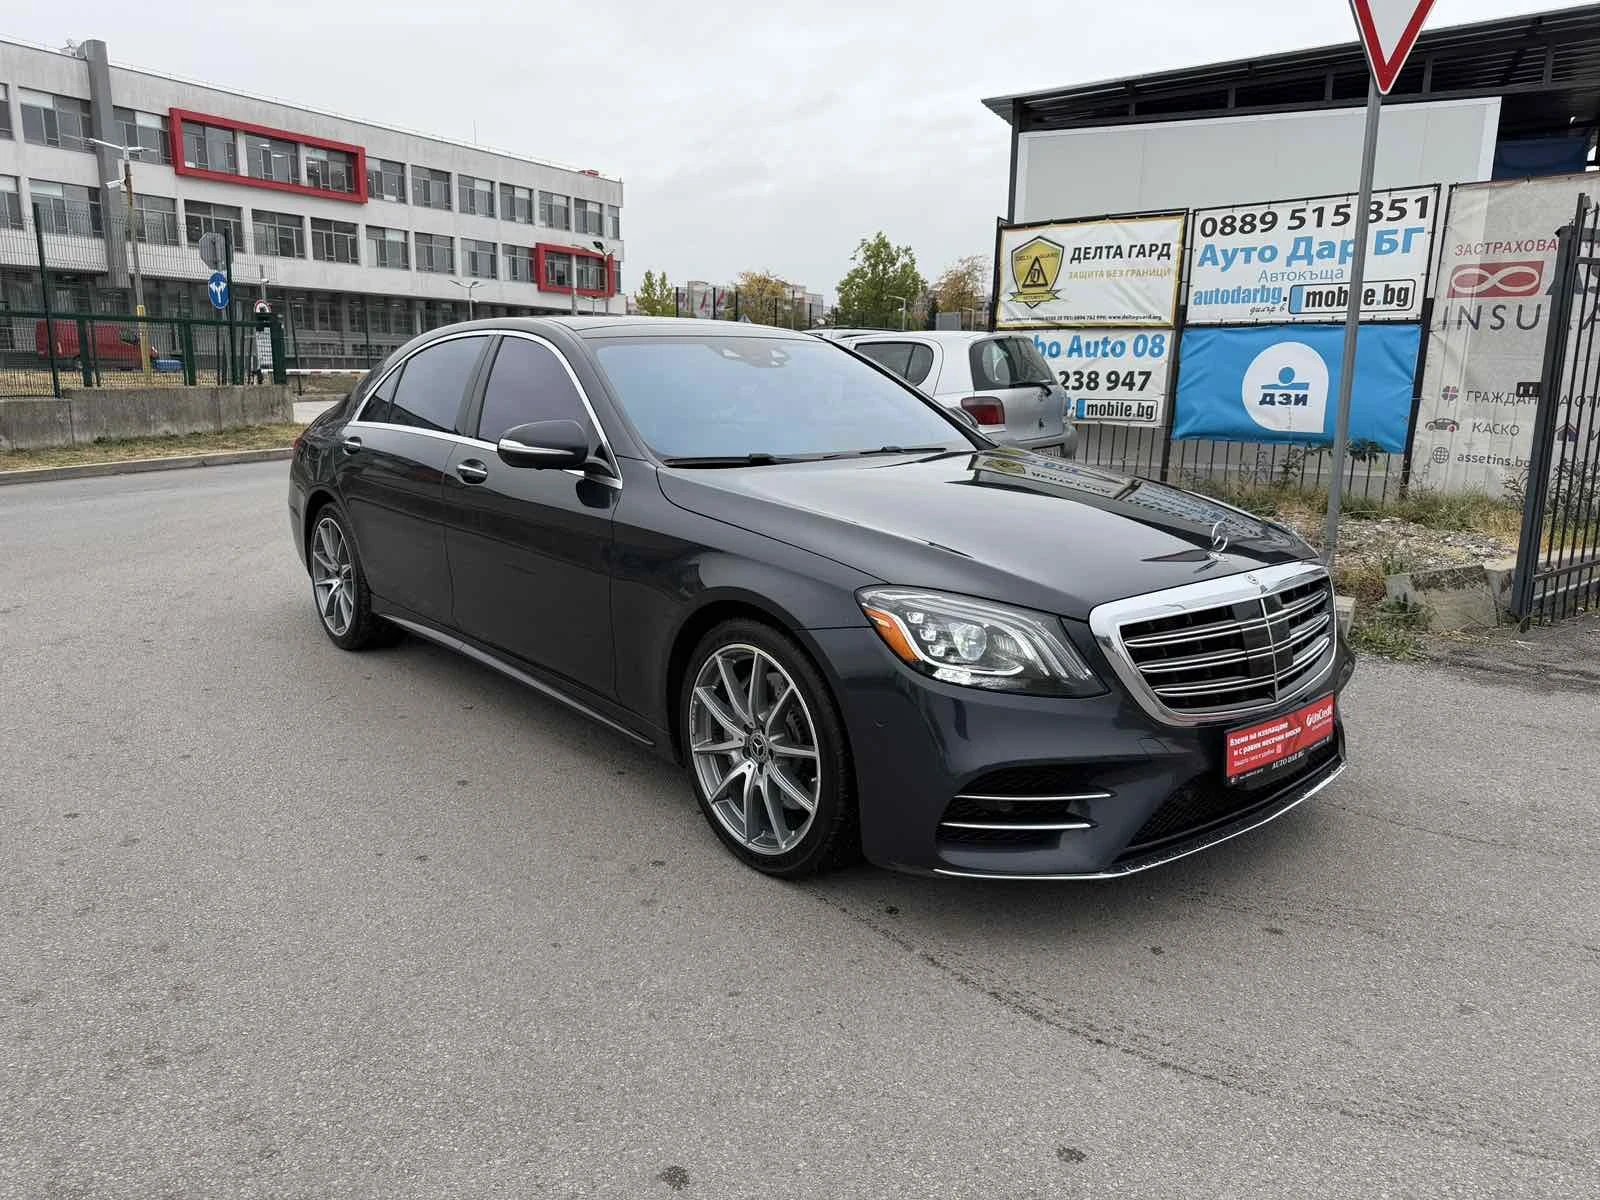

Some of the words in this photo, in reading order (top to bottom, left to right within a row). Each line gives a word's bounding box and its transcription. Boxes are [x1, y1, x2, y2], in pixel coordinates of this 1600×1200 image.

[1200, 211, 1279, 238] 0889
[1287, 203, 1352, 230] 515
[1368, 195, 1430, 224] 851
[1069, 244, 1124, 264] ДЕЛТА
[1127, 242, 1172, 260] ГАРД
[1197, 243, 1279, 273] Ауто
[1285, 236, 1355, 268] Дар
[1374, 226, 1425, 256] БГ
[1455, 238, 1560, 257] ЗАСТРАХОВА
[1068, 271, 1105, 280] ЗАЩИТА
[1258, 267, 1345, 284] Автокъща
[1304, 284, 1410, 308] mobe.bg
[1442, 303, 1542, 331] INSU
[1033, 334, 1061, 358] bo
[1067, 335, 1126, 358] Auto
[1133, 334, 1165, 358] 08
[1059, 370, 1100, 391] 238
[1106, 370, 1152, 391] 947
[1258, 392, 1308, 406] ДЗИ
[1086, 401, 1154, 420] mobile.bg
[1471, 422, 1520, 437] КАСКО
